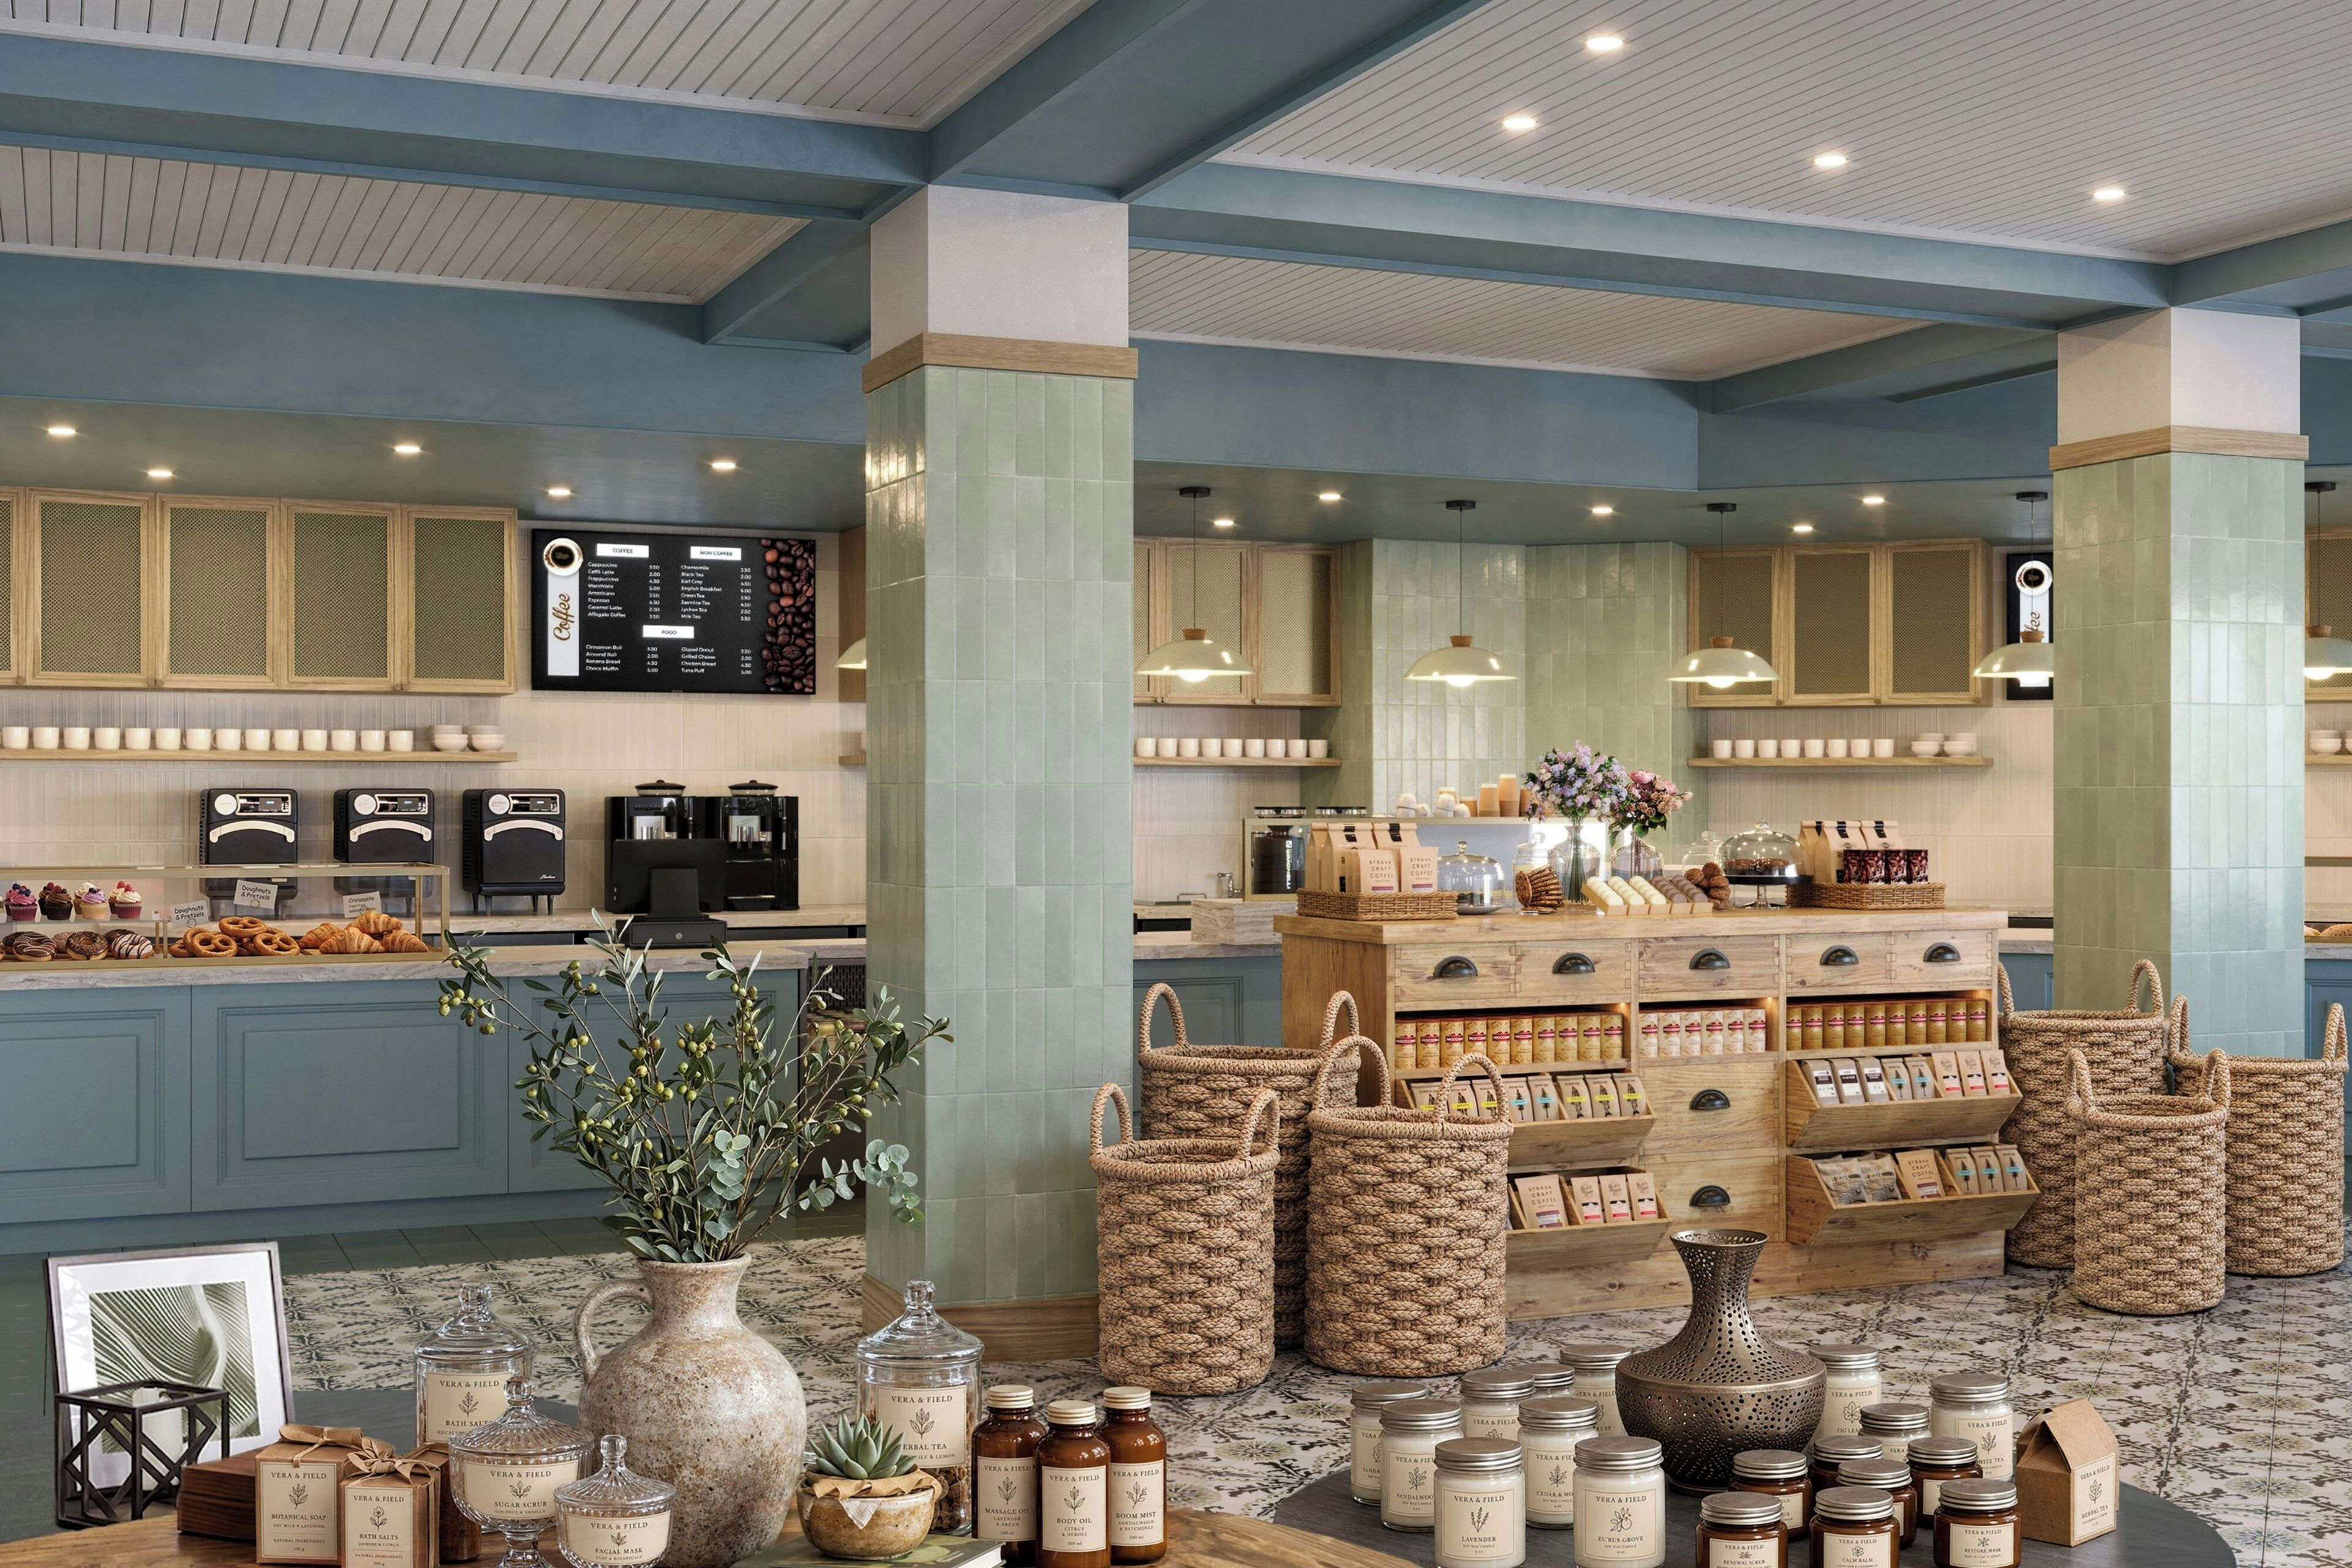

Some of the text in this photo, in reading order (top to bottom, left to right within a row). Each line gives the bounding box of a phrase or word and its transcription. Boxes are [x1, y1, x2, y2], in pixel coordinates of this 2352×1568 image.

[552, 592, 575, 641] Coffee
[242, 885, 271, 894] Doughnuts
[175, 905, 204, 914] Doughnuts
[2082, 1508, 2099, 1519] HERBAL
